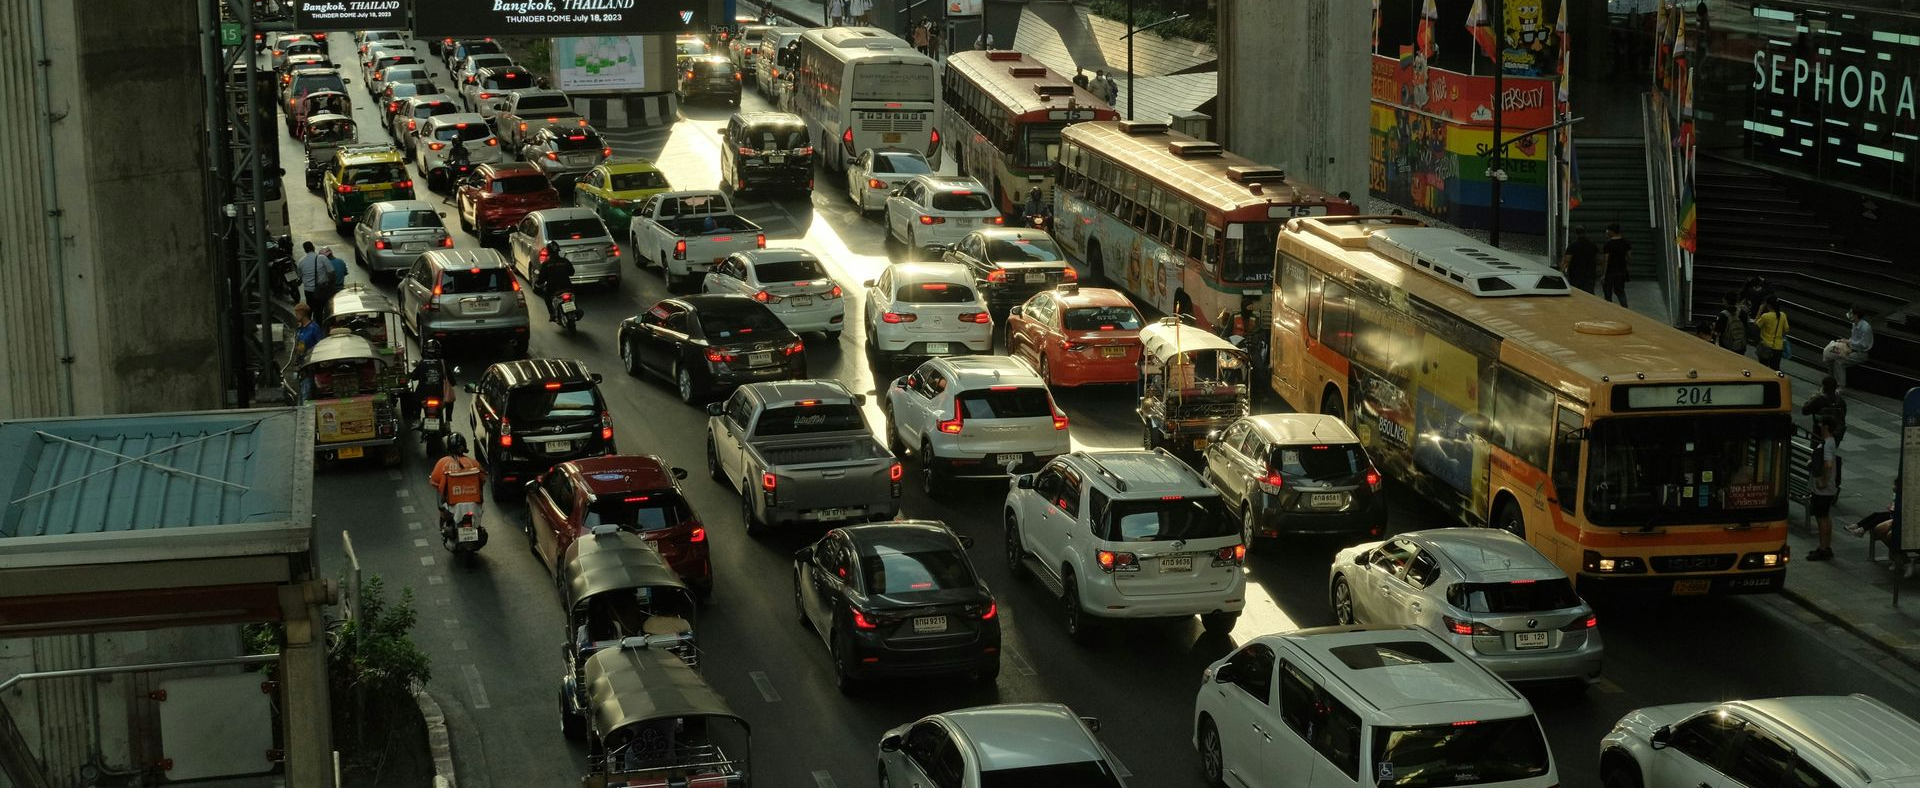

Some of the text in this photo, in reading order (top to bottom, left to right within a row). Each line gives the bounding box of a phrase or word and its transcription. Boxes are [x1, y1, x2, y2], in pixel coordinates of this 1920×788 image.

[303, 1, 400, 12] Bangkok, THAILAND
[492, 0, 634, 12] Bangkok, THAILAND
[506, 15, 547, 23] THUNDER
[572, 15, 589, 23] July
[590, 14, 602, 22] 18,
[602, 14, 622, 22] 2023
[222, 29, 236, 41] 15
[1753, 50, 1916, 120] SEPHORA
[1064, 111, 1081, 120] 15
[1287, 205, 1311, 218] 15
[1676, 387, 1713, 405] 204
